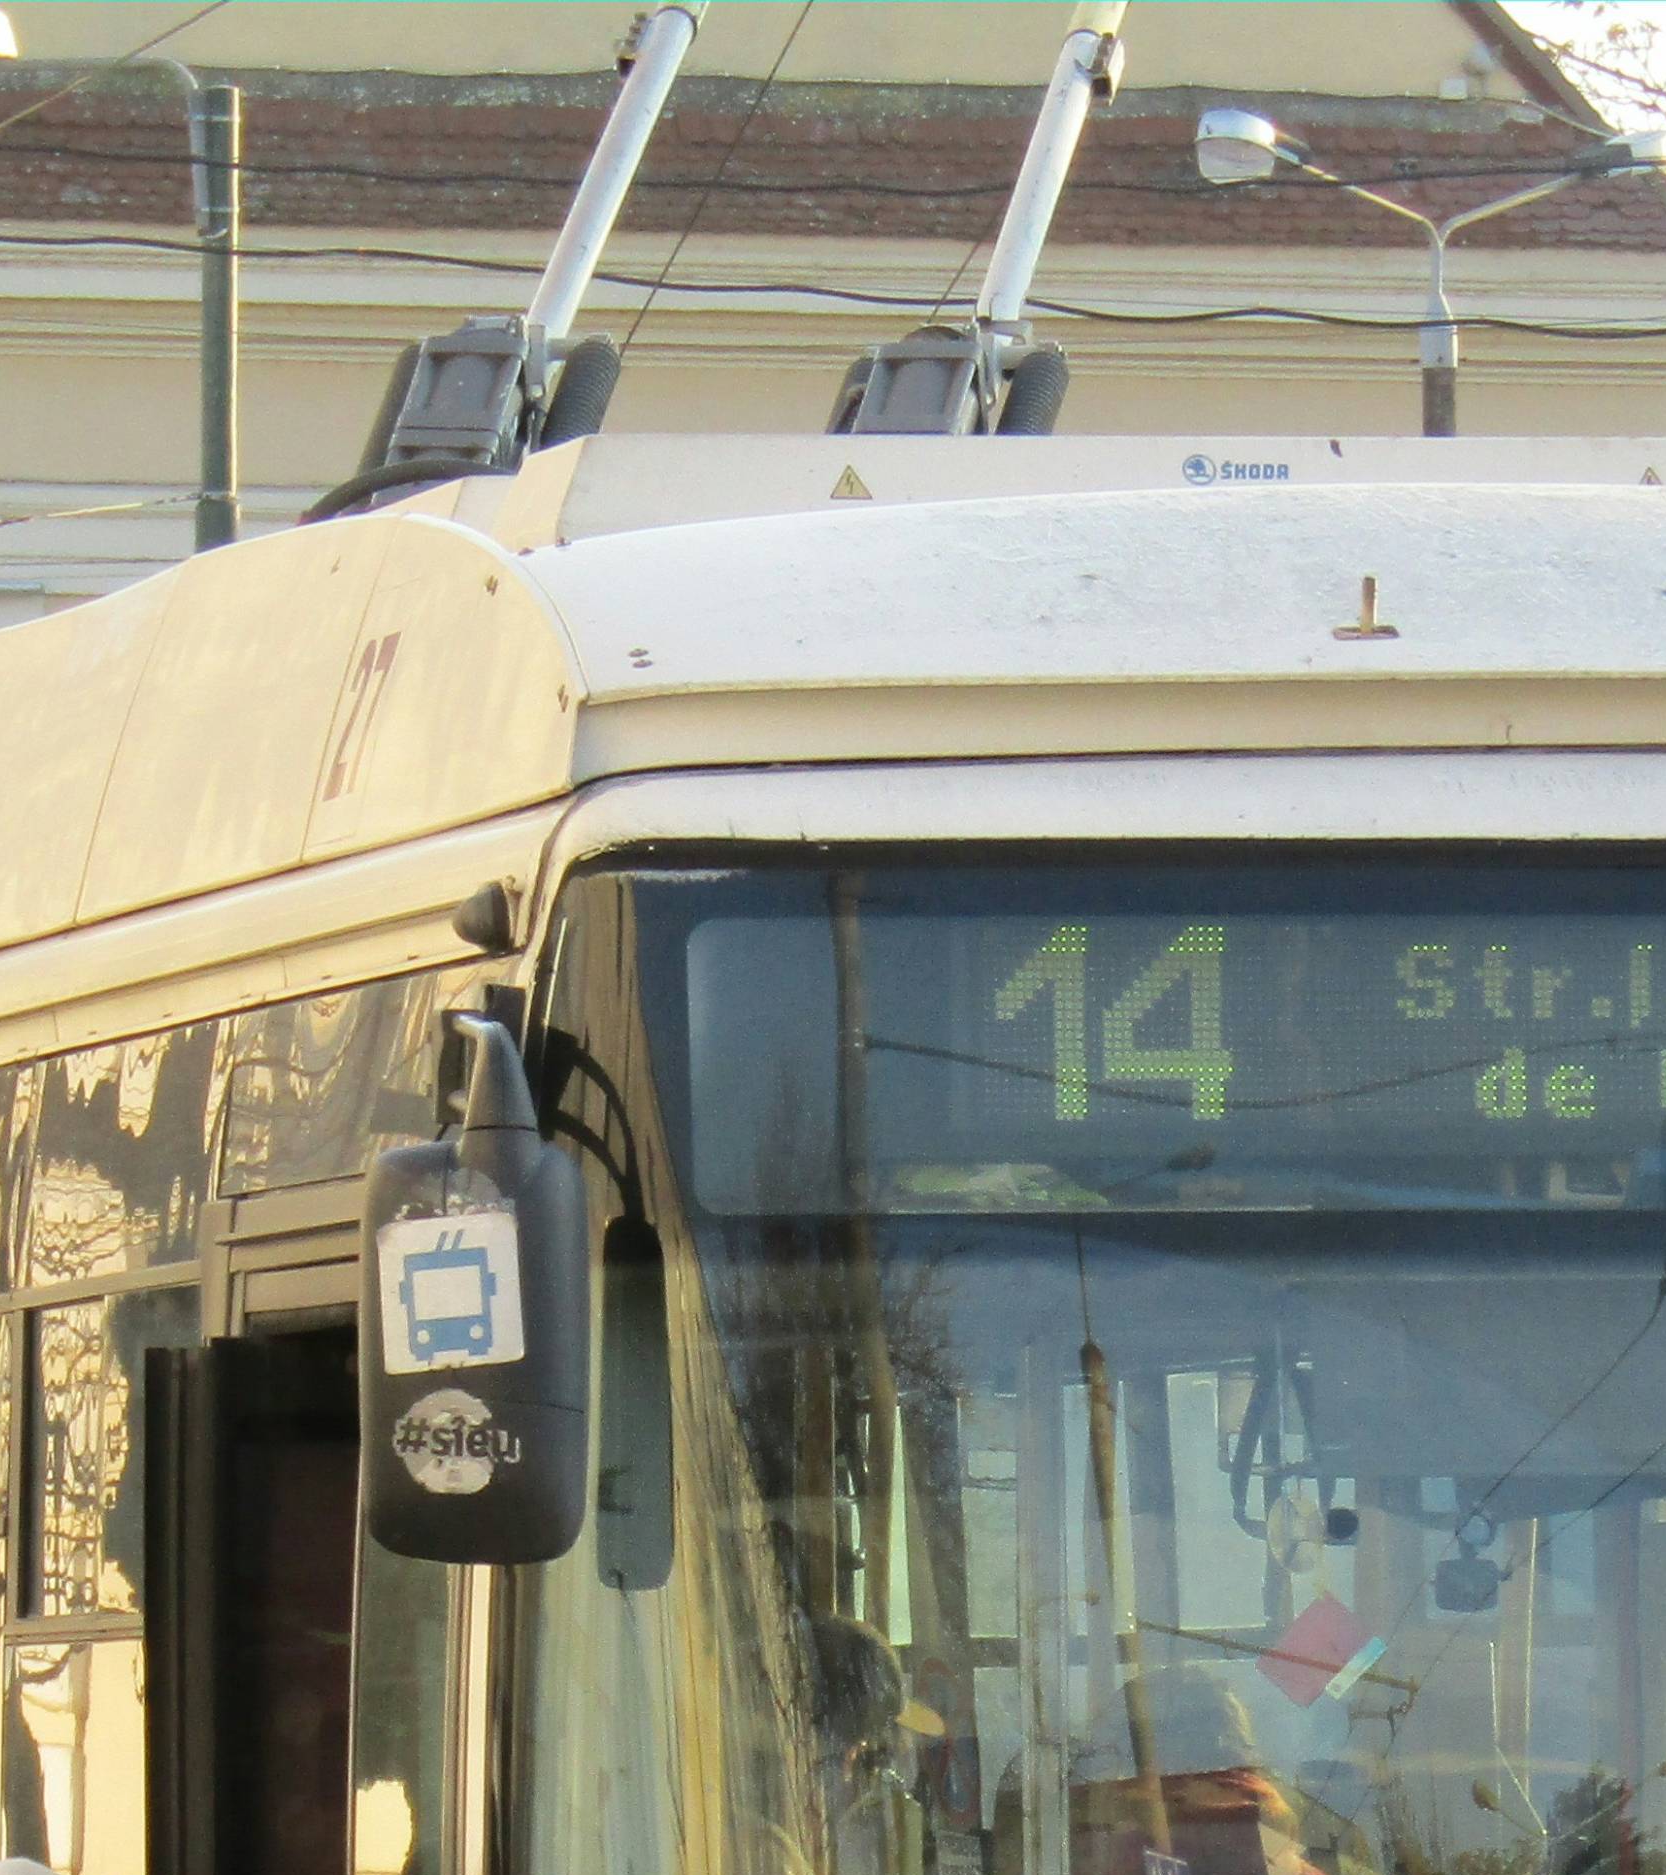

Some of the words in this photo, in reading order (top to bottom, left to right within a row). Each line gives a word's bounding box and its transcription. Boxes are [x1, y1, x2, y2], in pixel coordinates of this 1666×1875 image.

[322, 631, 402, 802] 27
[994, 926, 1234, 1121] 14
[1476, 1047, 1596, 1119] de
